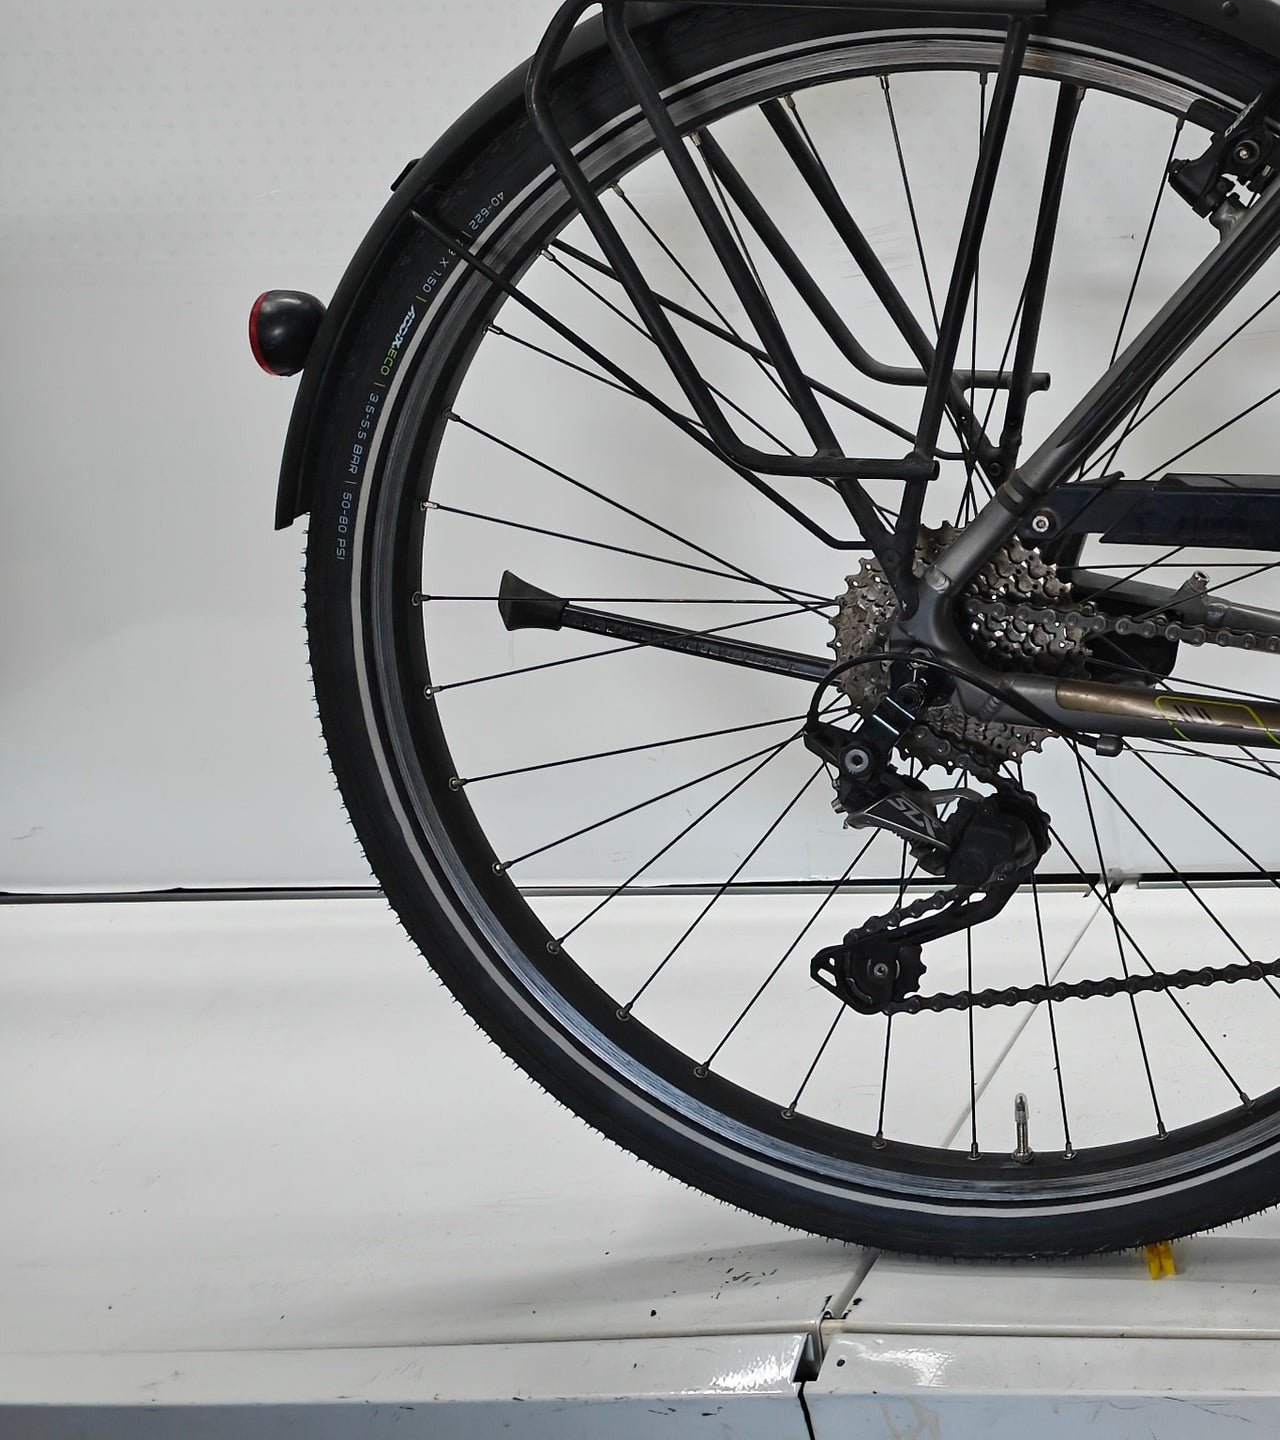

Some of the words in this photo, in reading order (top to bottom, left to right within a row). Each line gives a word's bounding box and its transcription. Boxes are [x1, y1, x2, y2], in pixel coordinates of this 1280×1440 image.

[468, 191, 504, 230] 40-622
[357, 392, 380, 440] 3.5-5.5
[348, 443, 364, 475] BAR
[337, 491, 353, 534] 50-80
[336, 537, 347, 560] PSI
[886, 797, 944, 839] SLX
